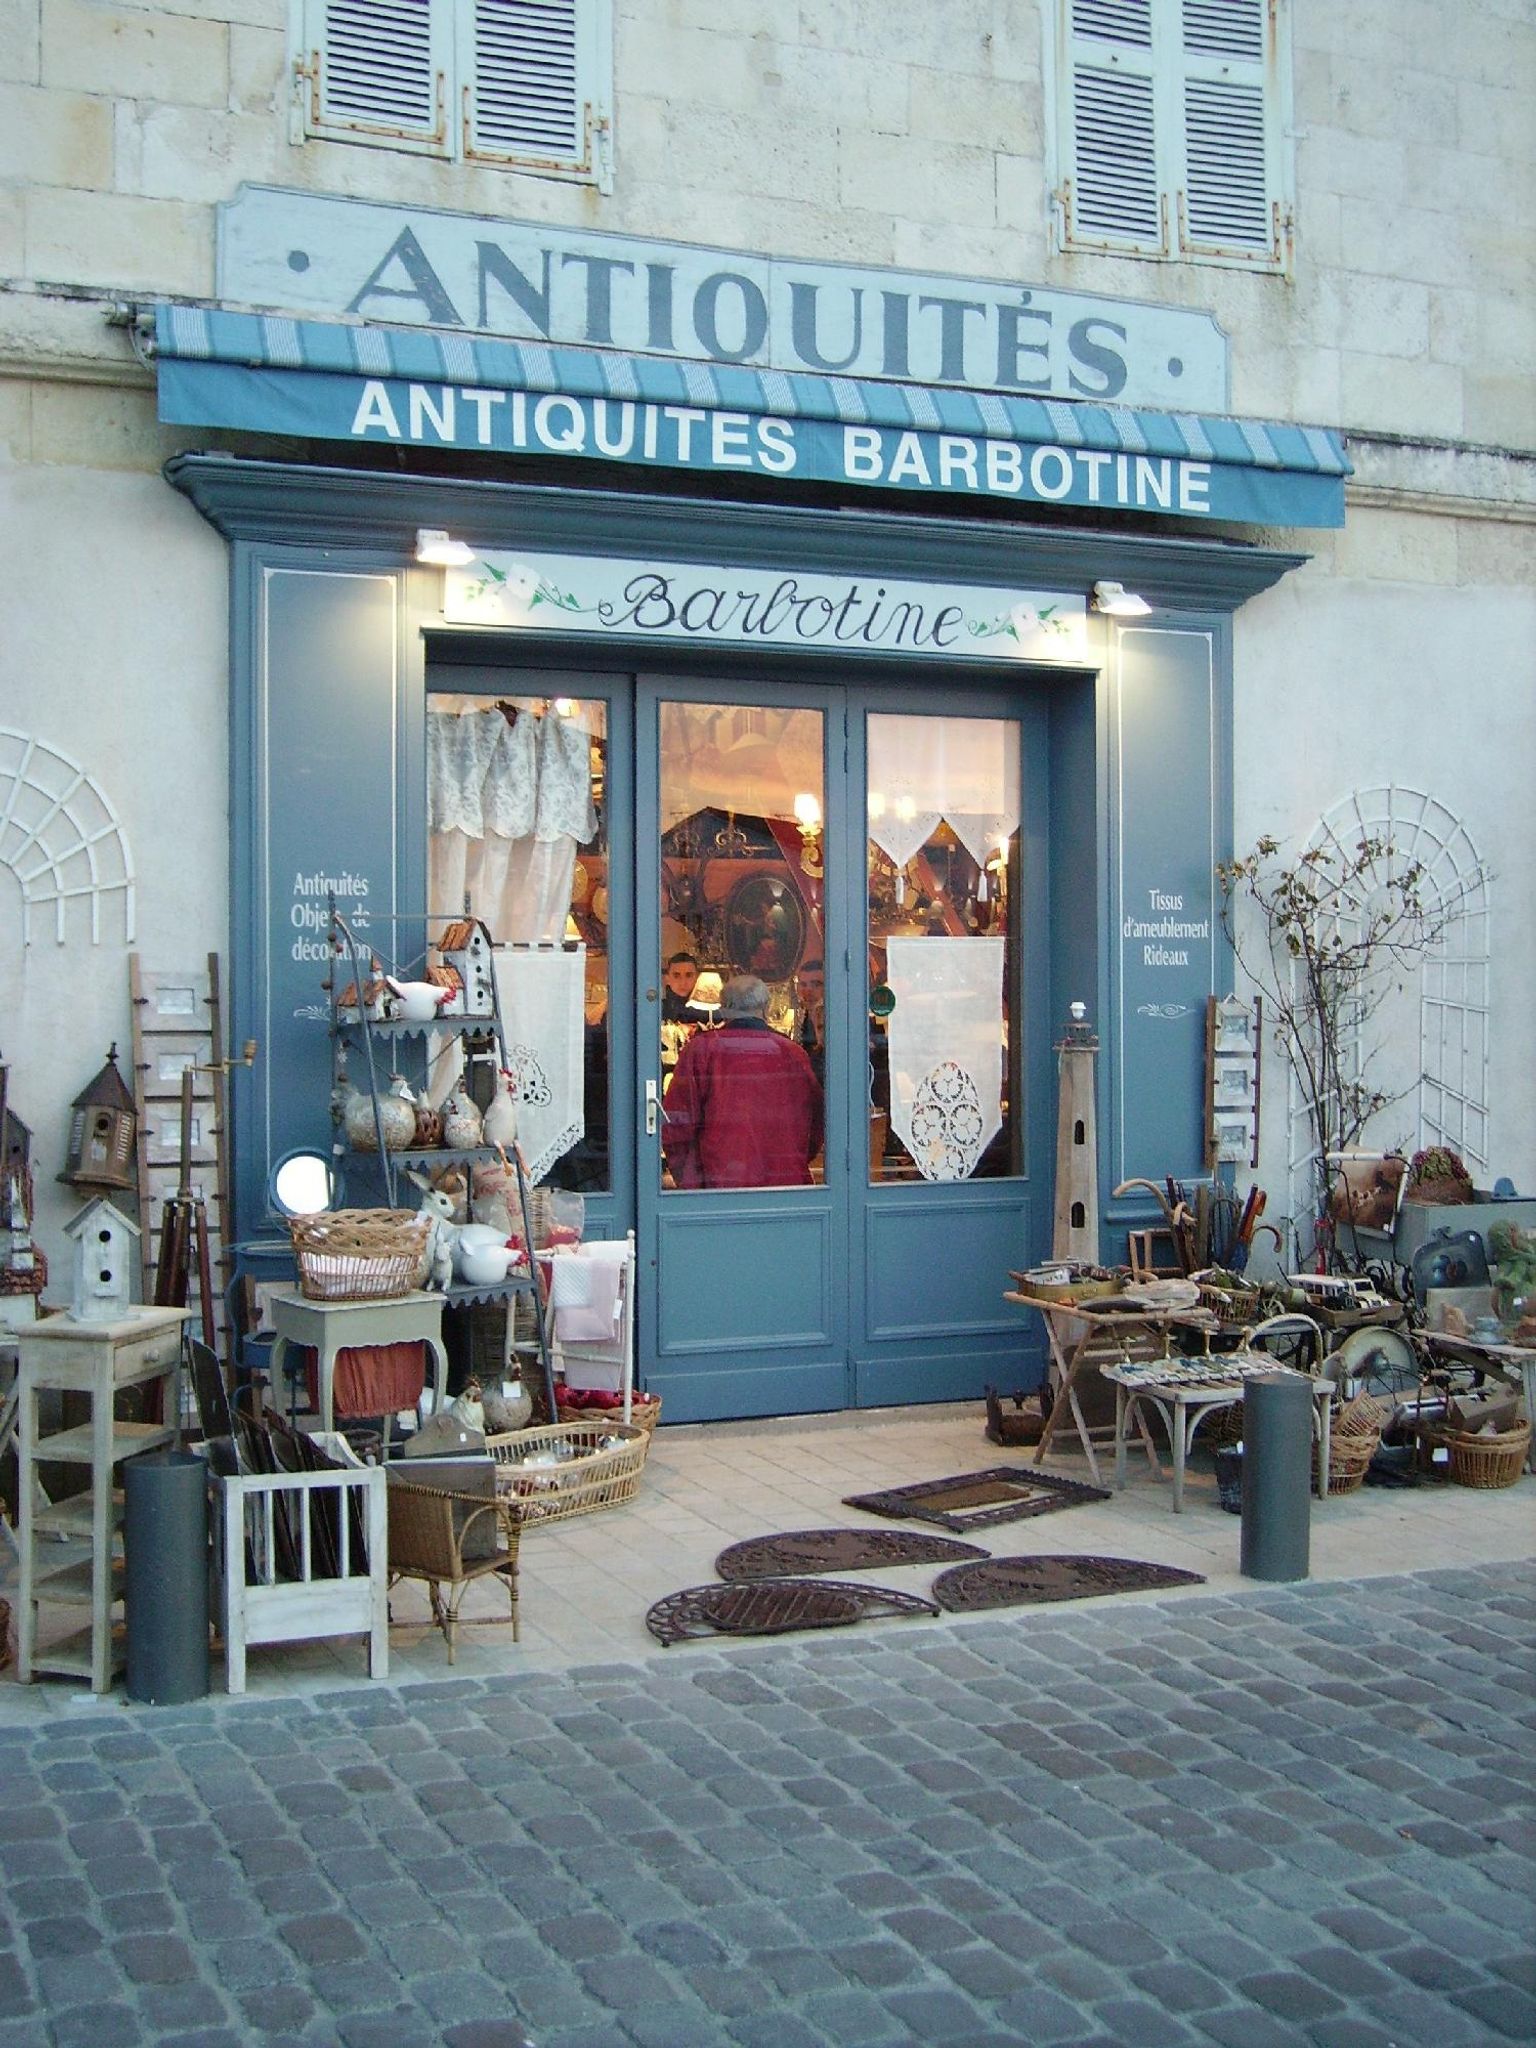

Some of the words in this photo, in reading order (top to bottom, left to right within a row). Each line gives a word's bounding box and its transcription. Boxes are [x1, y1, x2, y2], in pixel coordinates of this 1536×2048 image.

[352, 381, 797, 473] ANTIQUITES
[844, 426, 1212, 513] BARBOTINE
[600, 573, 963, 647] Barbotine
[1148, 888, 1183, 911] Tissus
[351, 903, 370, 928] de
[1123, 916, 1209, 938] d'ameublement
[1143, 944, 1189, 966] Rideaux
